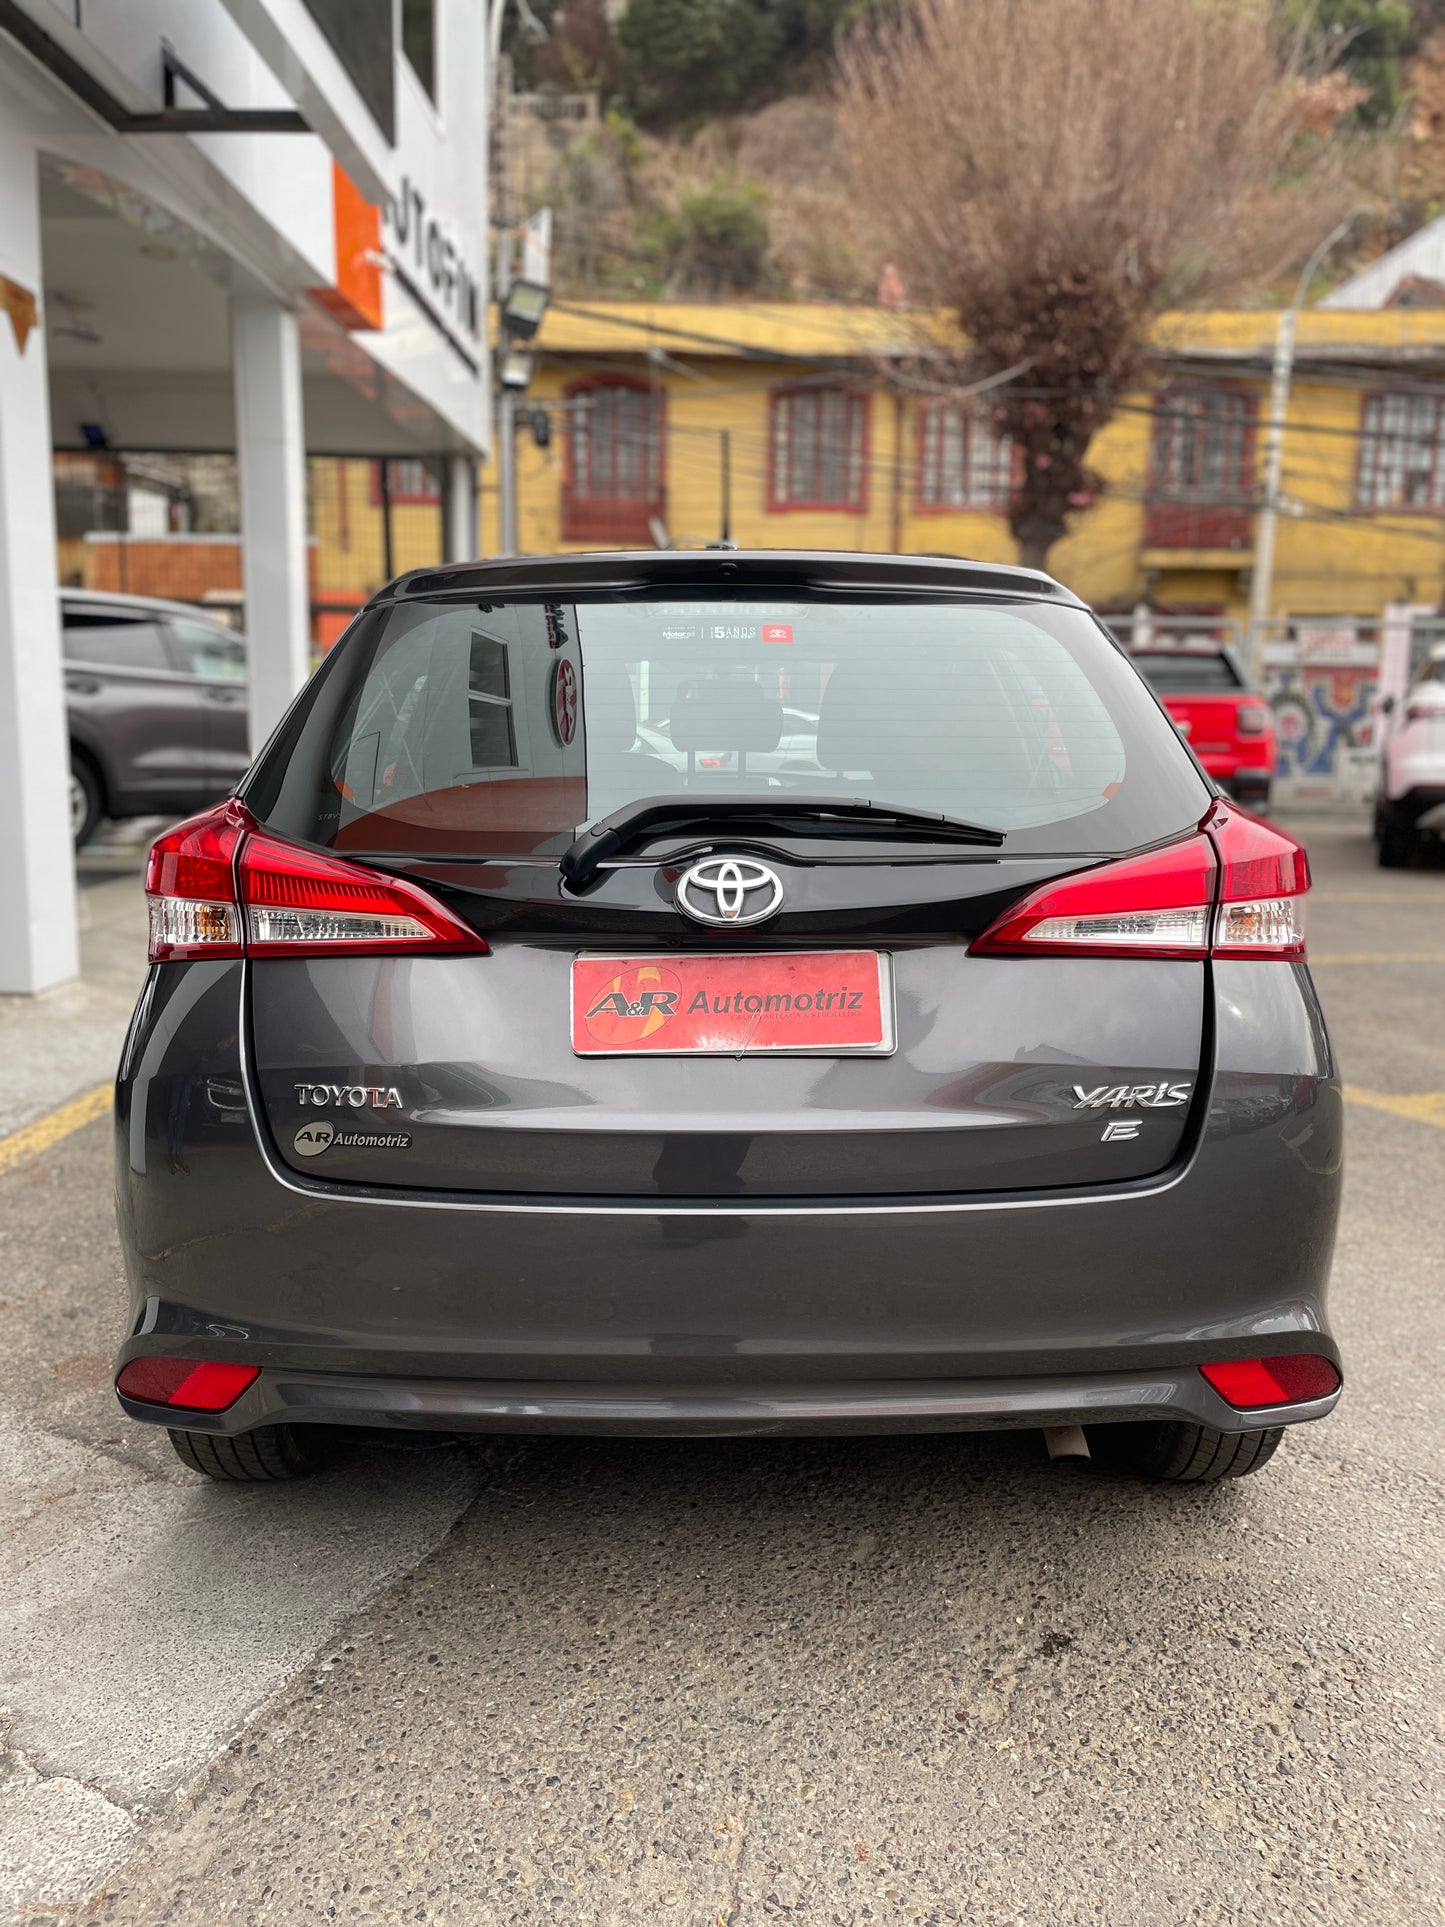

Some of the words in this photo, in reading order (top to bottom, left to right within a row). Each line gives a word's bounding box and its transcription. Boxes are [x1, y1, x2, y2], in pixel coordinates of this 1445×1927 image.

[714, 626, 725, 639] 5
[584, 991, 679, 1018] A&R
[687, 986, 864, 1014] Automotriz
[294, 1084, 403, 1109] TOYOTA
[295, 1131, 331, 1144] AR
[333, 1132, 409, 1147] Automotriz
[1100, 1120, 1143, 1142] E
